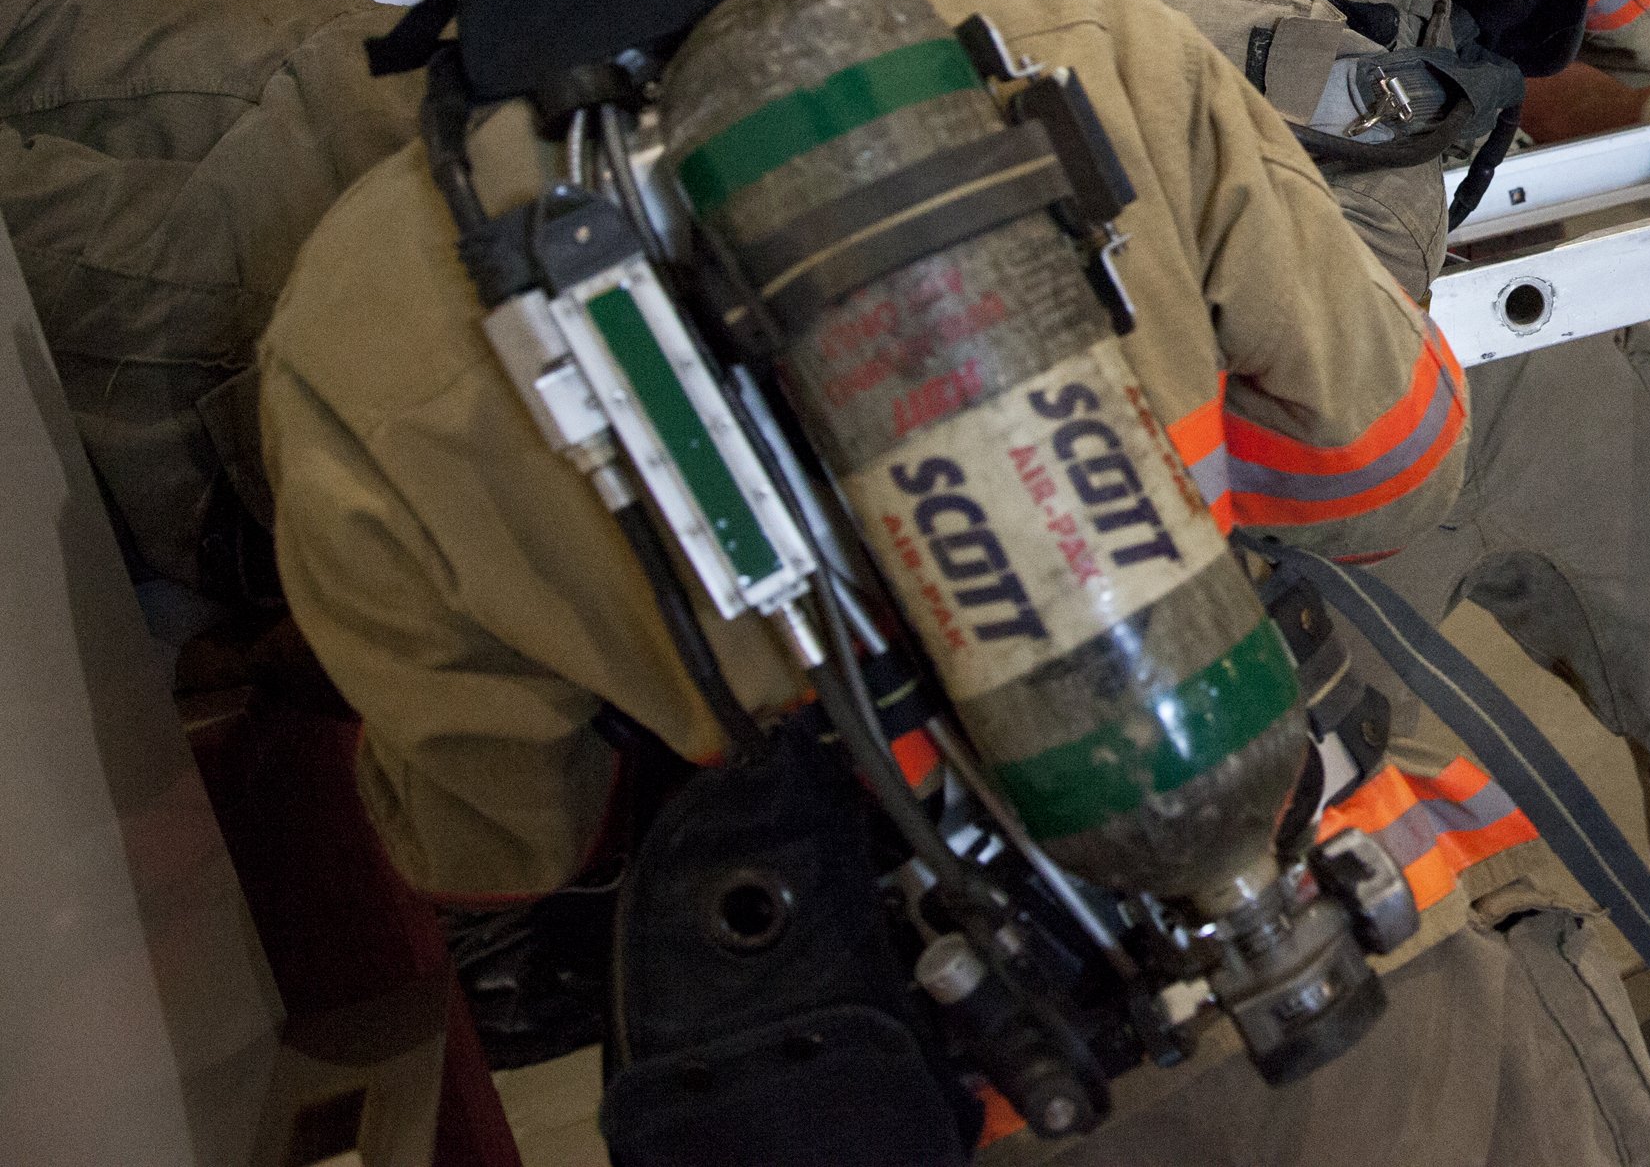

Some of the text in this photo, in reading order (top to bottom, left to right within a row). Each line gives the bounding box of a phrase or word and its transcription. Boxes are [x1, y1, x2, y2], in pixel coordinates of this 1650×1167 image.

[889, 455, 1049, 642] SCOTT
[1027, 382, 1183, 567] SCOTT
[881, 514, 968, 652] AIR-PAK
